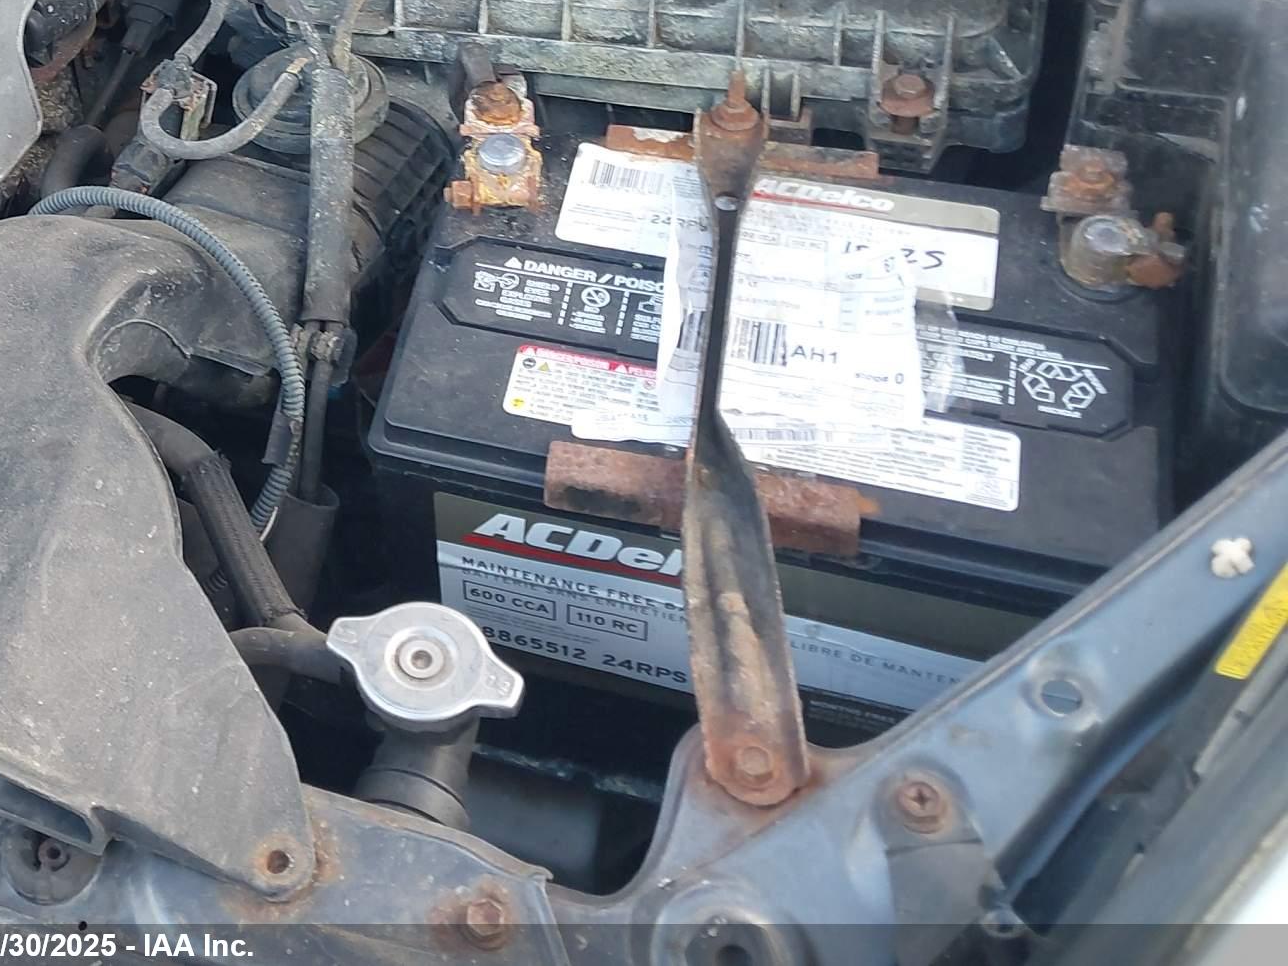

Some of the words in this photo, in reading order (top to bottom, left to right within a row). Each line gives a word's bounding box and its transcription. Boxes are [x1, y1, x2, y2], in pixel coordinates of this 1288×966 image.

[754, 178, 895, 212] ACDelco
[790, 344, 840, 365] AH1
[462, 555, 599, 596] MAINTENANCE
[607, 588, 655, 608] FREE
[470, 587, 506, 604] 600
[512, 596, 550, 615] CCA
[576, 611, 607, 626] 110
[612, 619, 639, 634] RC
[790, 640, 843, 659] LIBRE
[849, 652, 874, 667] DE
[602, 653, 688, 684] 24RPS
